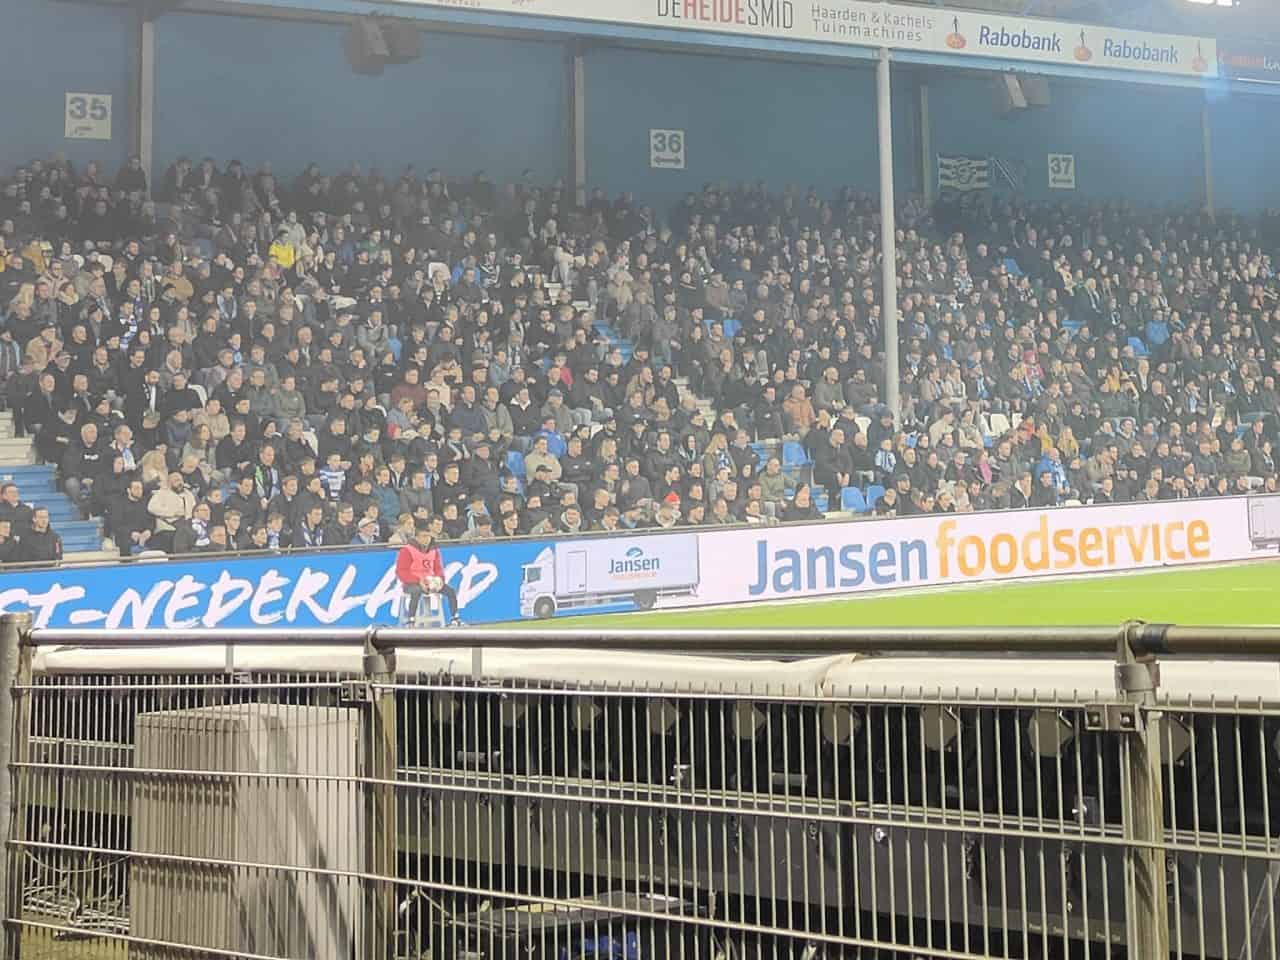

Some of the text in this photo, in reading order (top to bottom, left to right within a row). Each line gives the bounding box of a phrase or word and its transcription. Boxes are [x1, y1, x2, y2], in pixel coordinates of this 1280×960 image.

[811, 3, 933, 29] Haarden & Kachels
[813, 19, 922, 41] Tuinmachines
[979, 25, 1062, 52] Rabobank
[1104, 38, 1179, 64] Rabobank
[69, 96, 108, 120] 35
[653, 132, 682, 153] 36
[1050, 157, 1073, 174] 37
[607, 557, 661, 574] Jansen
[748, 515, 1211, 597] Jansen foodservice
[0, 554, 498, 629] T-NEDERLAD
